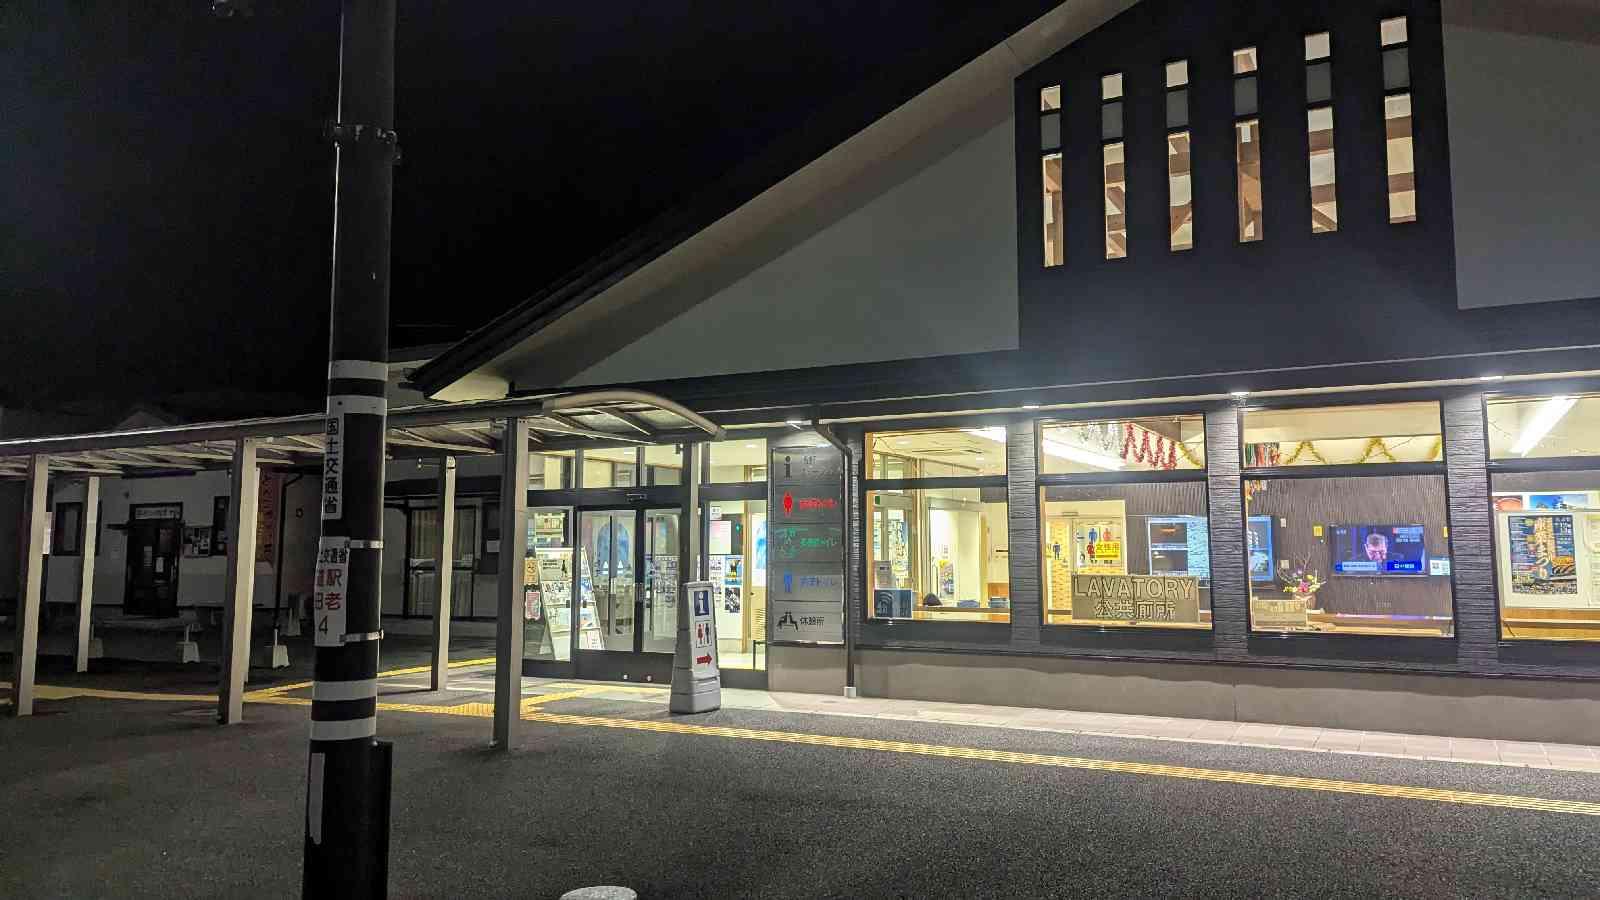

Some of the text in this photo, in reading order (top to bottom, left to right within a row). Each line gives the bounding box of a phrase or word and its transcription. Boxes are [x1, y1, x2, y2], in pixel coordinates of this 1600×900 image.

[325, 418, 339, 514] 国土交通省
[1074, 577, 1194, 600] LAVATORY
[318, 615, 329, 634] 4
